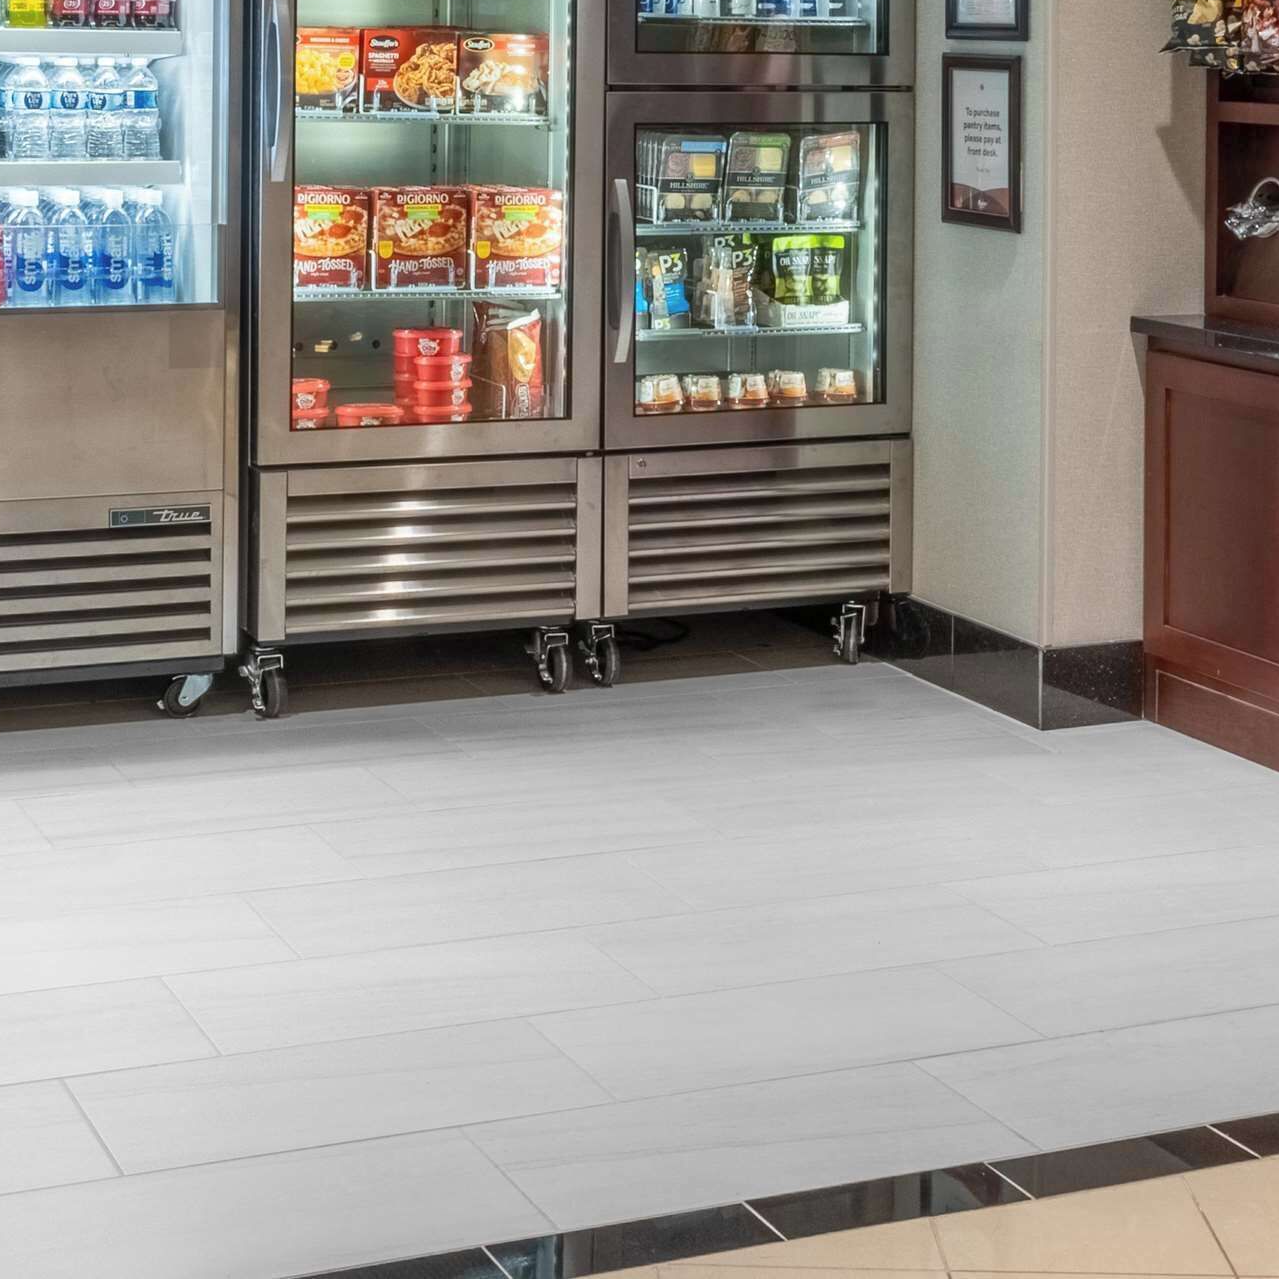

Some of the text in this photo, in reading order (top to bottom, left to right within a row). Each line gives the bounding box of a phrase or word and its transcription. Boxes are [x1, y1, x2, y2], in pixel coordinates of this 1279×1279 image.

[367, 52, 400, 60] SPAGHETTI
[297, 194, 351, 205] DIGIORNO
[396, 193, 449, 205] DIGIORNO
[495, 195, 546, 206] DIGIORNO
[659, 252, 683, 274] P3
[732, 248, 753, 269] P3
